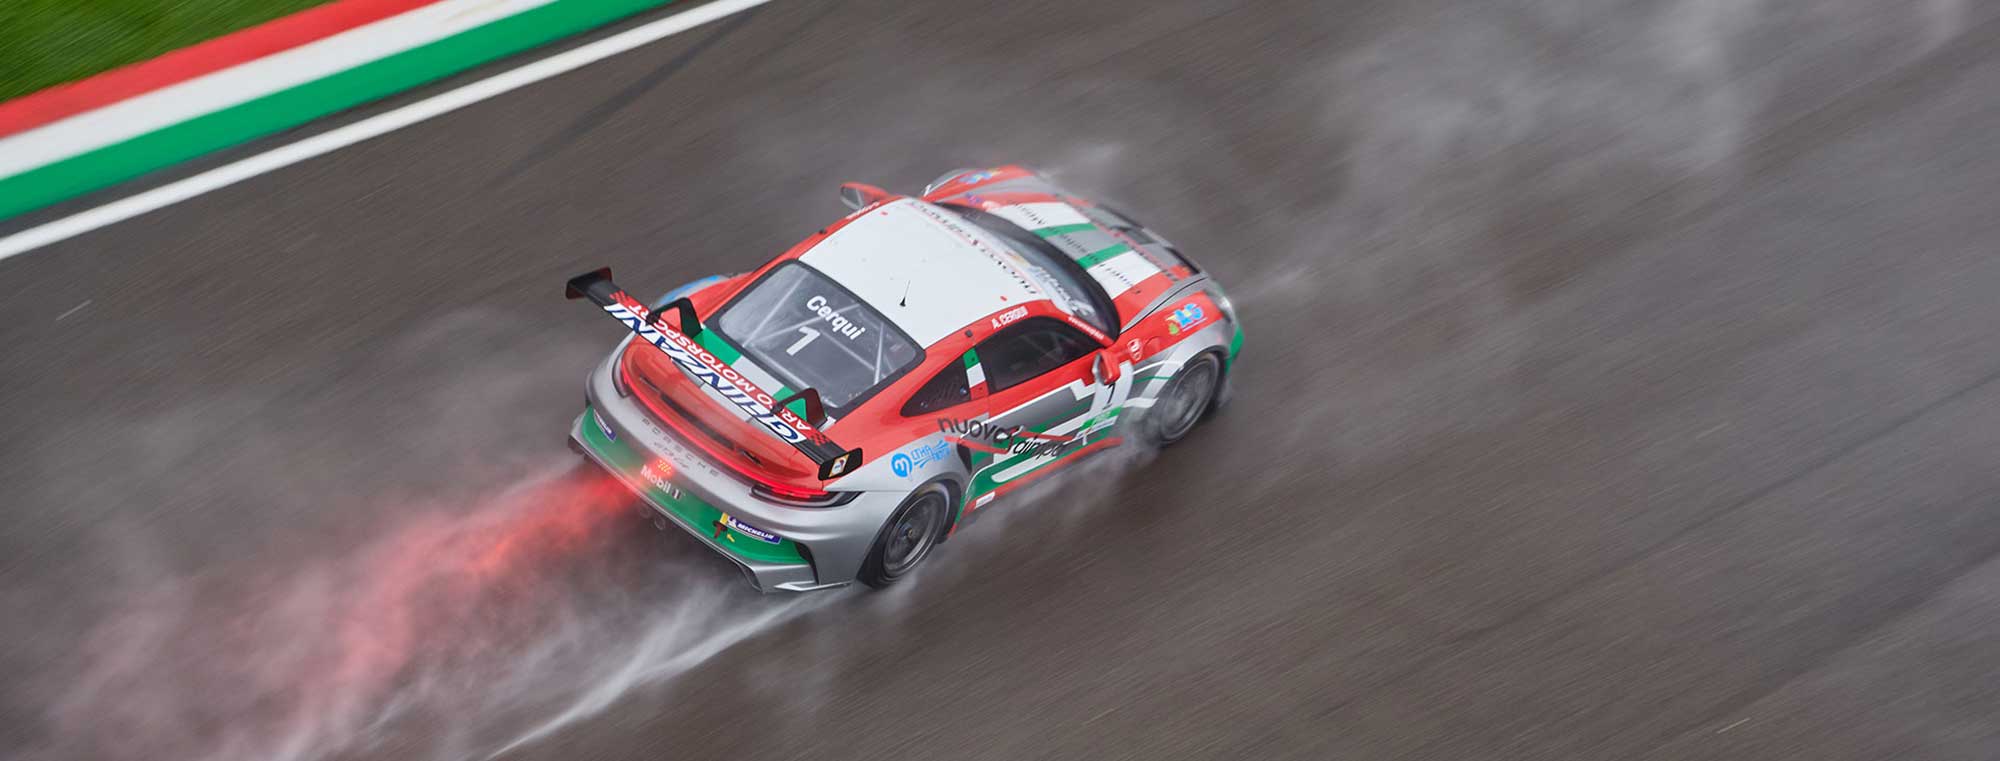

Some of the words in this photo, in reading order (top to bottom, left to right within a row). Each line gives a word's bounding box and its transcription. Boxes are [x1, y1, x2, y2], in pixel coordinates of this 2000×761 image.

[806, 295, 866, 340] Cerqui
[785, 326, 820, 356] 1
[607, 308, 799, 440] GHINZANI
[640, 464, 671, 493] Mobil
[737, 523, 775, 540] MICHELIN
